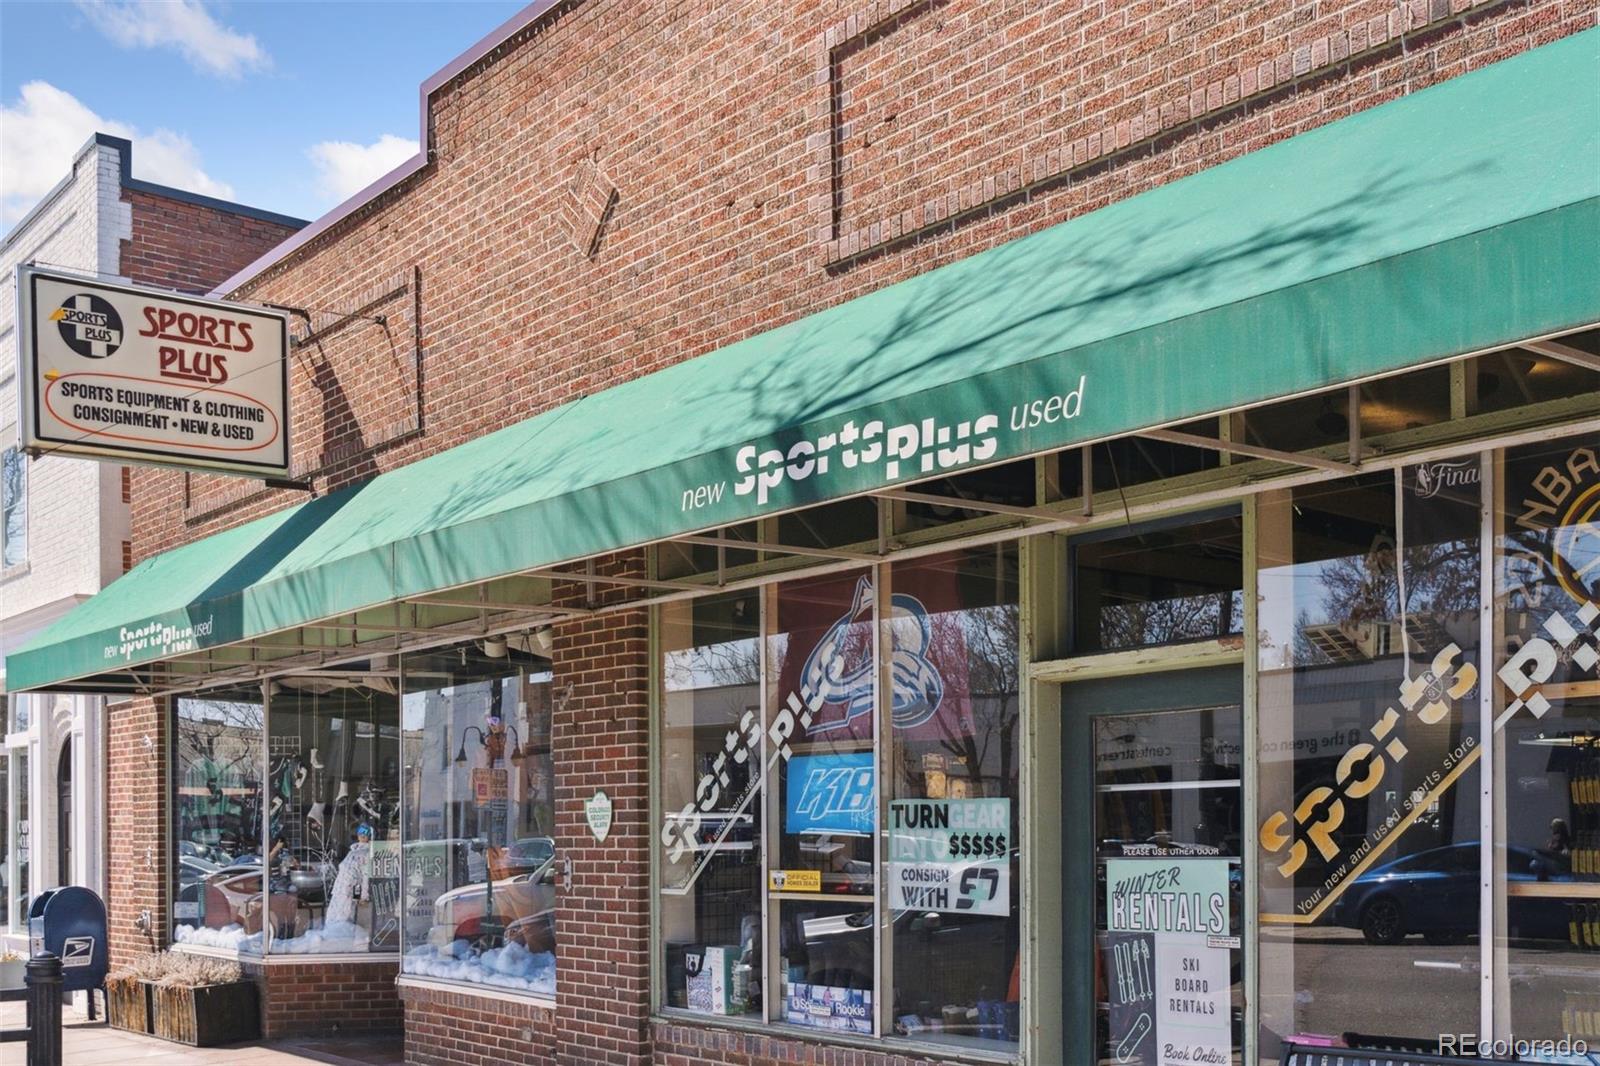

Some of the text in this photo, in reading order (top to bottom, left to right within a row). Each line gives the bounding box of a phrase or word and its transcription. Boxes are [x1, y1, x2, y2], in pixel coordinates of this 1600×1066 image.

[61, 309, 107, 327] SPORTS
[139, 306, 254, 352] SPORTS
[85, 327, 112, 343] PLUS
[160, 346, 228, 385] PLUS
[61, 381, 264, 423] SPORTS EQUIPMENT & CLOTHING
[73, 404, 254, 441] CONSIGNMENT NEW & USED
[682, 479, 726, 512] new
[1010, 375, 1086, 432] used
[1515, 448, 1600, 531] NBA
[193, 614, 213, 637] used
[891, 804, 949, 829] TURN
[949, 803, 1006, 829] GEAR
[1297, 734, 1476, 915] Your new and used sports store
[949, 832, 1007, 859] $$$$$
[1123, 848, 1150, 856] PLEASE
[1152, 848, 1168, 856] USE
[1169, 848, 1195, 856] OTHER
[901, 869, 949, 909] CONSIGN WITH
[1114, 866, 1181, 900] WINTER
[1112, 891, 1225, 934] RENTALS
[1182, 957, 1200, 971] SKI
[1175, 978, 1208, 993] BOARD
[1169, 998, 1215, 1015] RENTALS
[1163, 1043, 1228, 1065] Book Online
